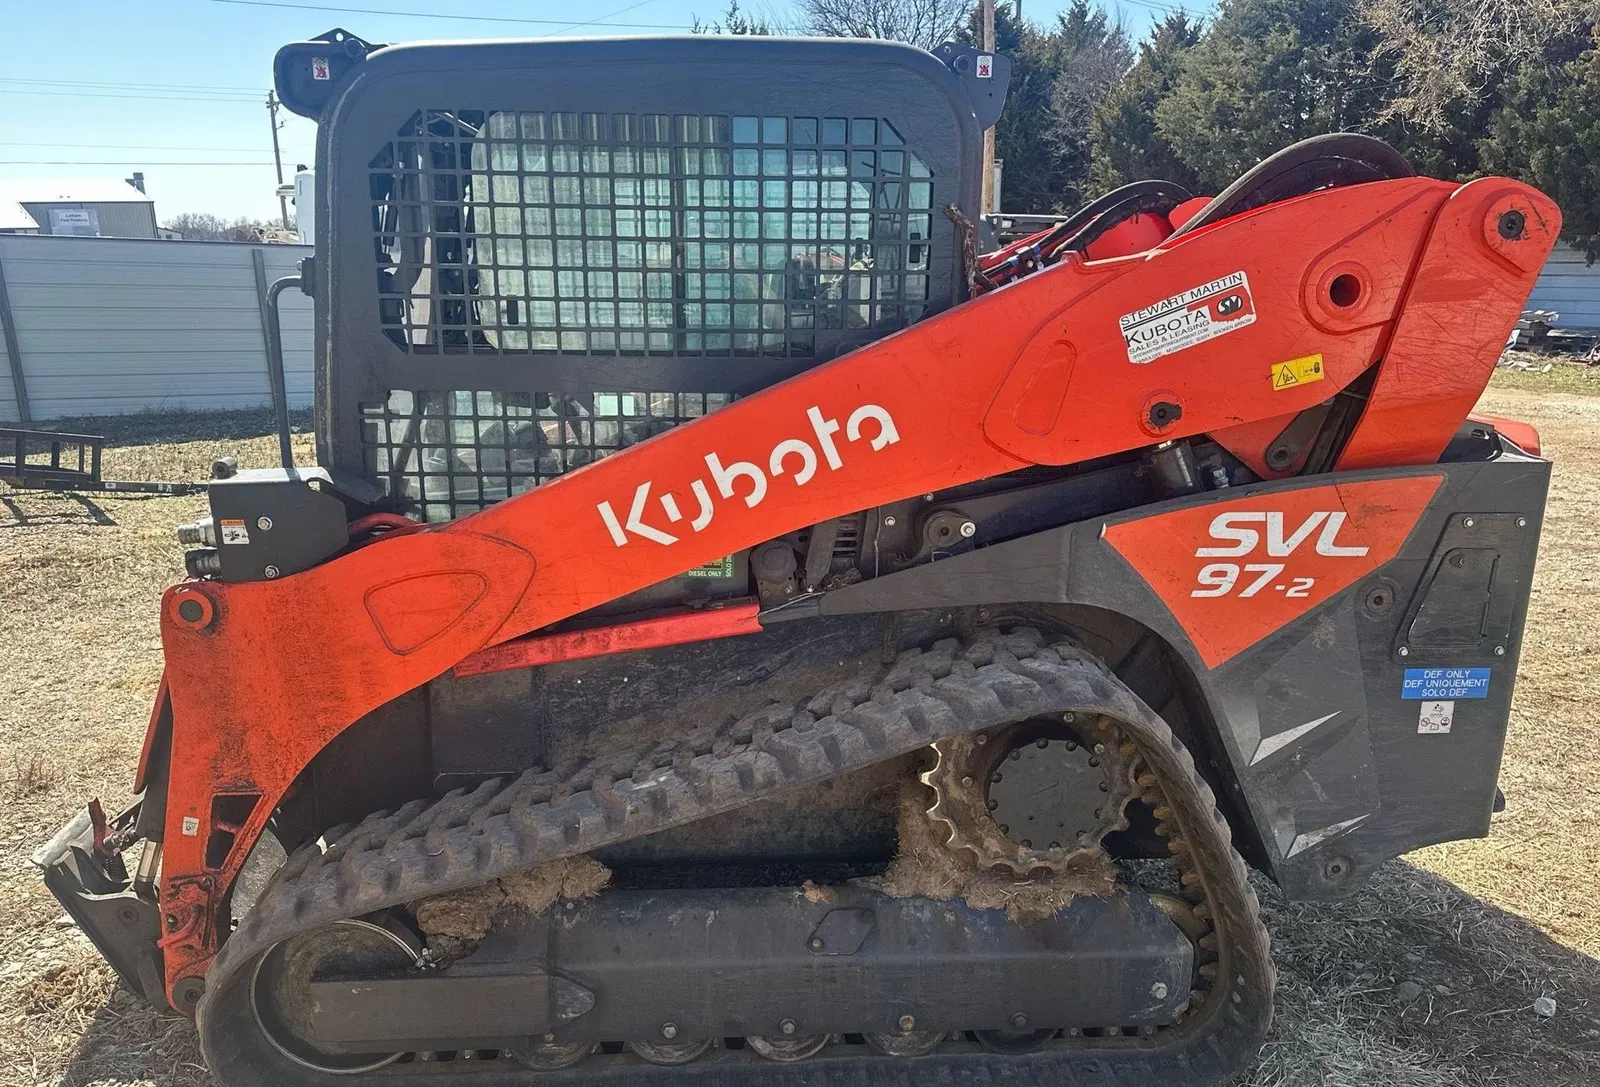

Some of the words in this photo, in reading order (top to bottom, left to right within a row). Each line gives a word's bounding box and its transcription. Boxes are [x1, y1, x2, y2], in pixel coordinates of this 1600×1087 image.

[1120, 293, 1186, 326] STEWART
[1190, 272, 1243, 300] MARTIN
[1125, 310, 1207, 348] KUBOTA
[1129, 339, 1159, 355] SALES
[1169, 320, 1210, 339] LEASING
[596, 404, 900, 548] Kubota
[1194, 511, 1370, 557] SVL
[1190, 563, 1315, 598] 97-2
[1404, 679, 1423, 688] DEF
[1425, 679, 1488, 688] UNIQUEMENT
[1424, 670, 1443, 679] DEF
[1446, 670, 1471, 679] ONLY
[1421, 688, 1447, 697] SOLO
[1449, 688, 1468, 697] DEF
